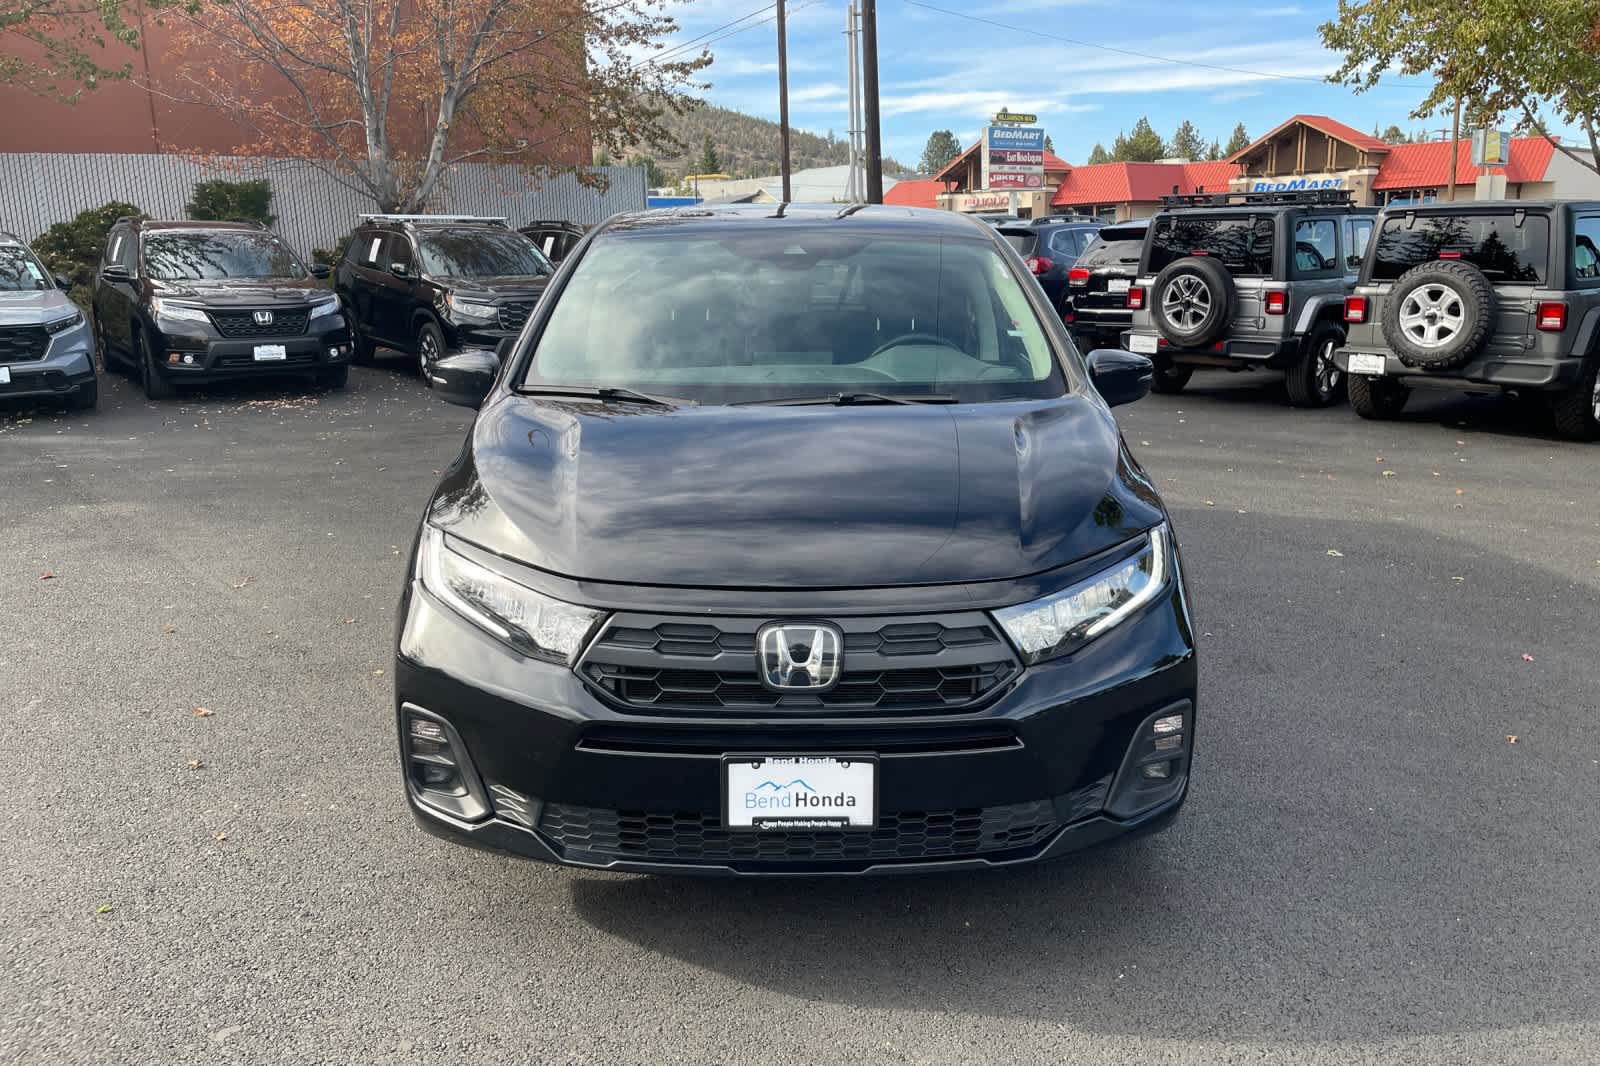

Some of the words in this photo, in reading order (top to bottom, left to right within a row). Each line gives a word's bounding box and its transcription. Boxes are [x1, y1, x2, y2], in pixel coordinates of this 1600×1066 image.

[1253, 178, 1343, 192] BEDMART
[745, 791, 791, 809] Bend
[795, 791, 856, 807] Honda
